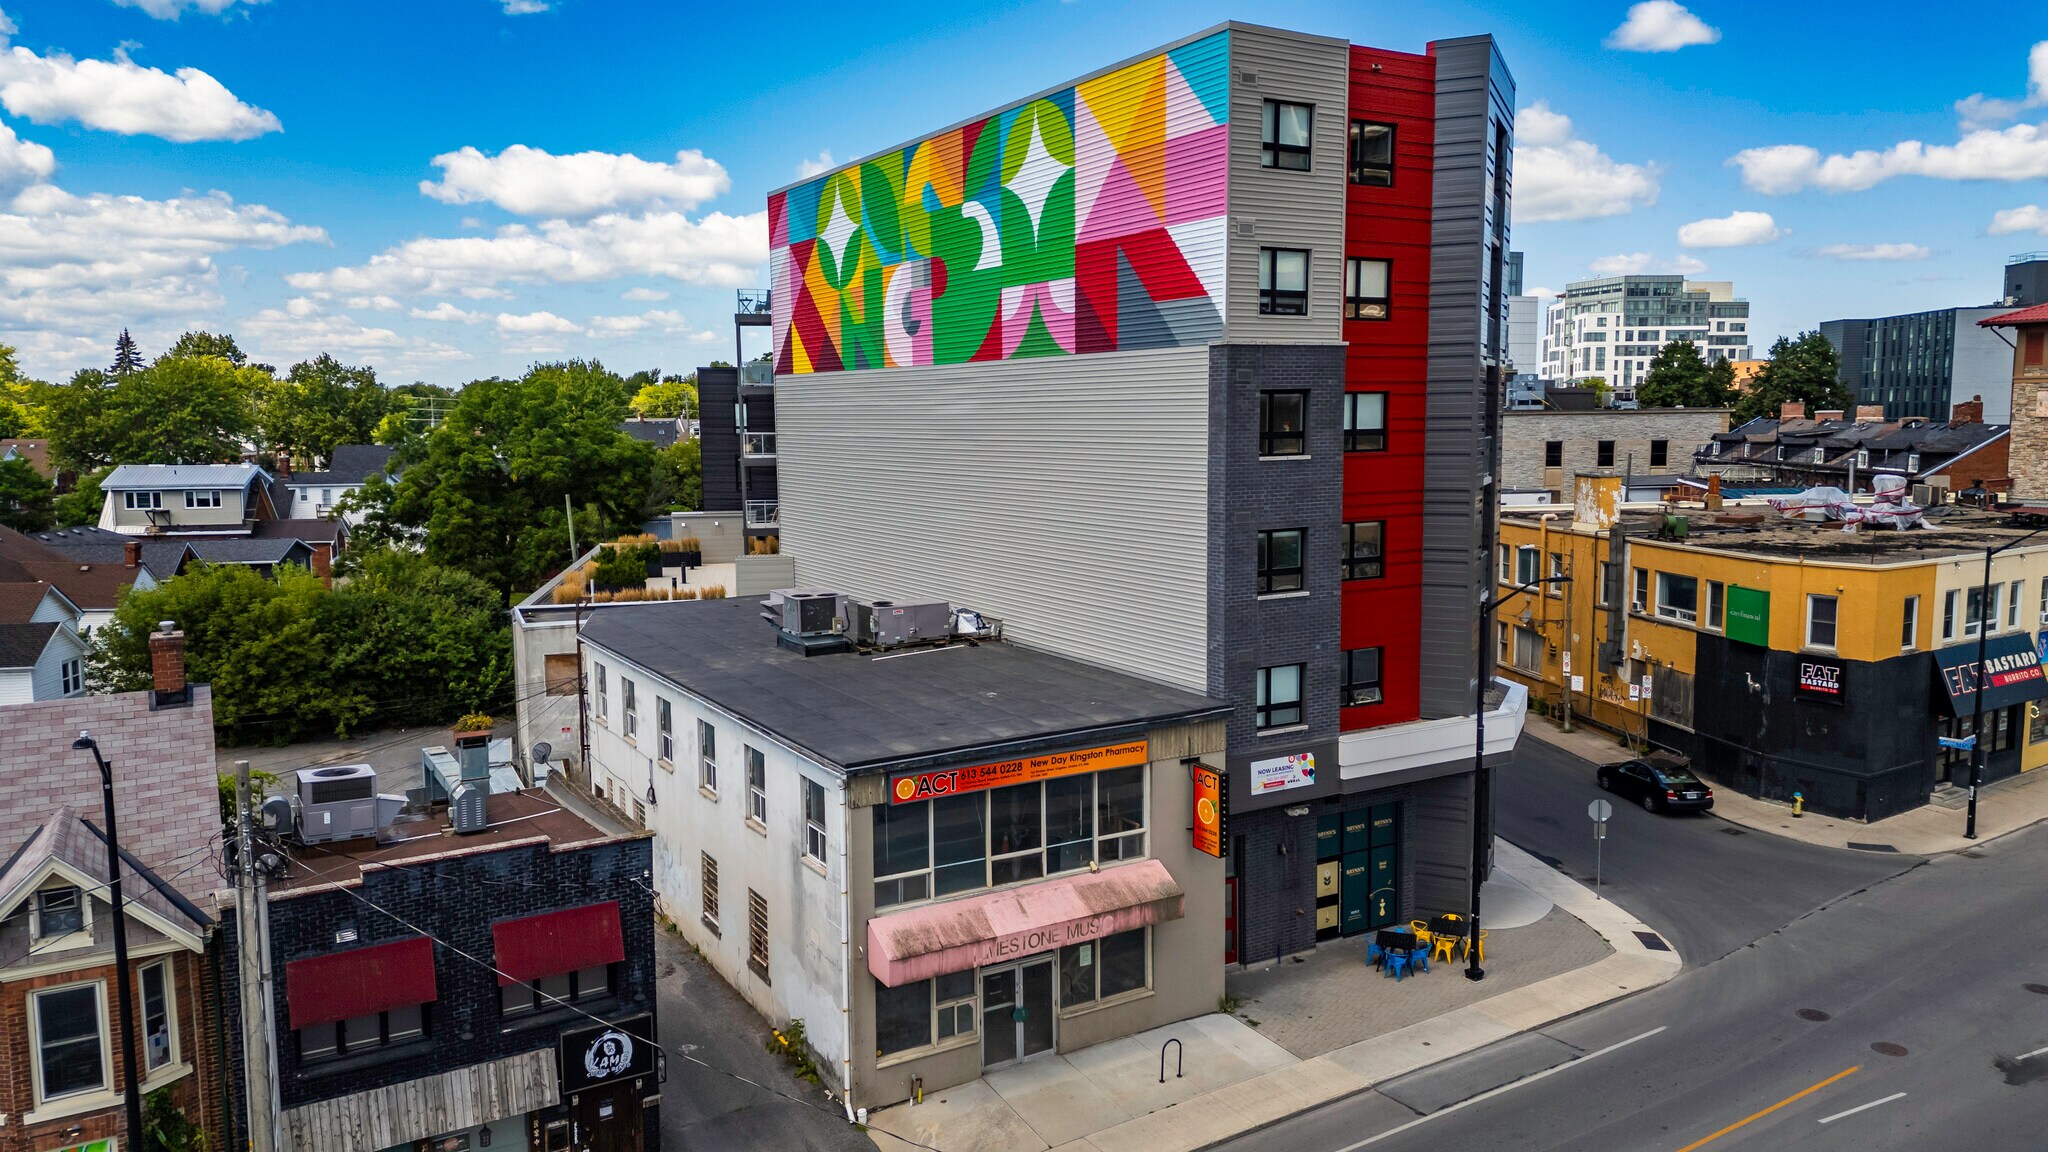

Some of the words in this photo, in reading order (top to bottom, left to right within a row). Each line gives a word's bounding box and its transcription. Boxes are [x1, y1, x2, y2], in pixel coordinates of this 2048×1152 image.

[1801, 662, 1840, 682] FAT
[1943, 661, 1990, 696] FAT
[1985, 651, 2038, 674] BASTARD
[2004, 671, 2028, 683] BURRITO
[2030, 668, 2042, 677] CO.
[1800, 677, 1840, 689] BASTARD
[1030, 759, 1049, 768] New
[1051, 756, 1067, 765] Day
[1069, 750, 1103, 763] Kingston
[1105, 744, 1145, 757] Pharmacy
[916, 770, 959, 797] ACT
[960, 769, 977, 780] 613
[979, 765, 997, 777] 544
[1000, 762, 1023, 774] 0228
[1257, 767, 1271, 776] NOW
[1272, 764, 1295, 774] LEASING
[1197, 772, 1217, 790] ACT
[589, 1051, 630, 1072] KAME
